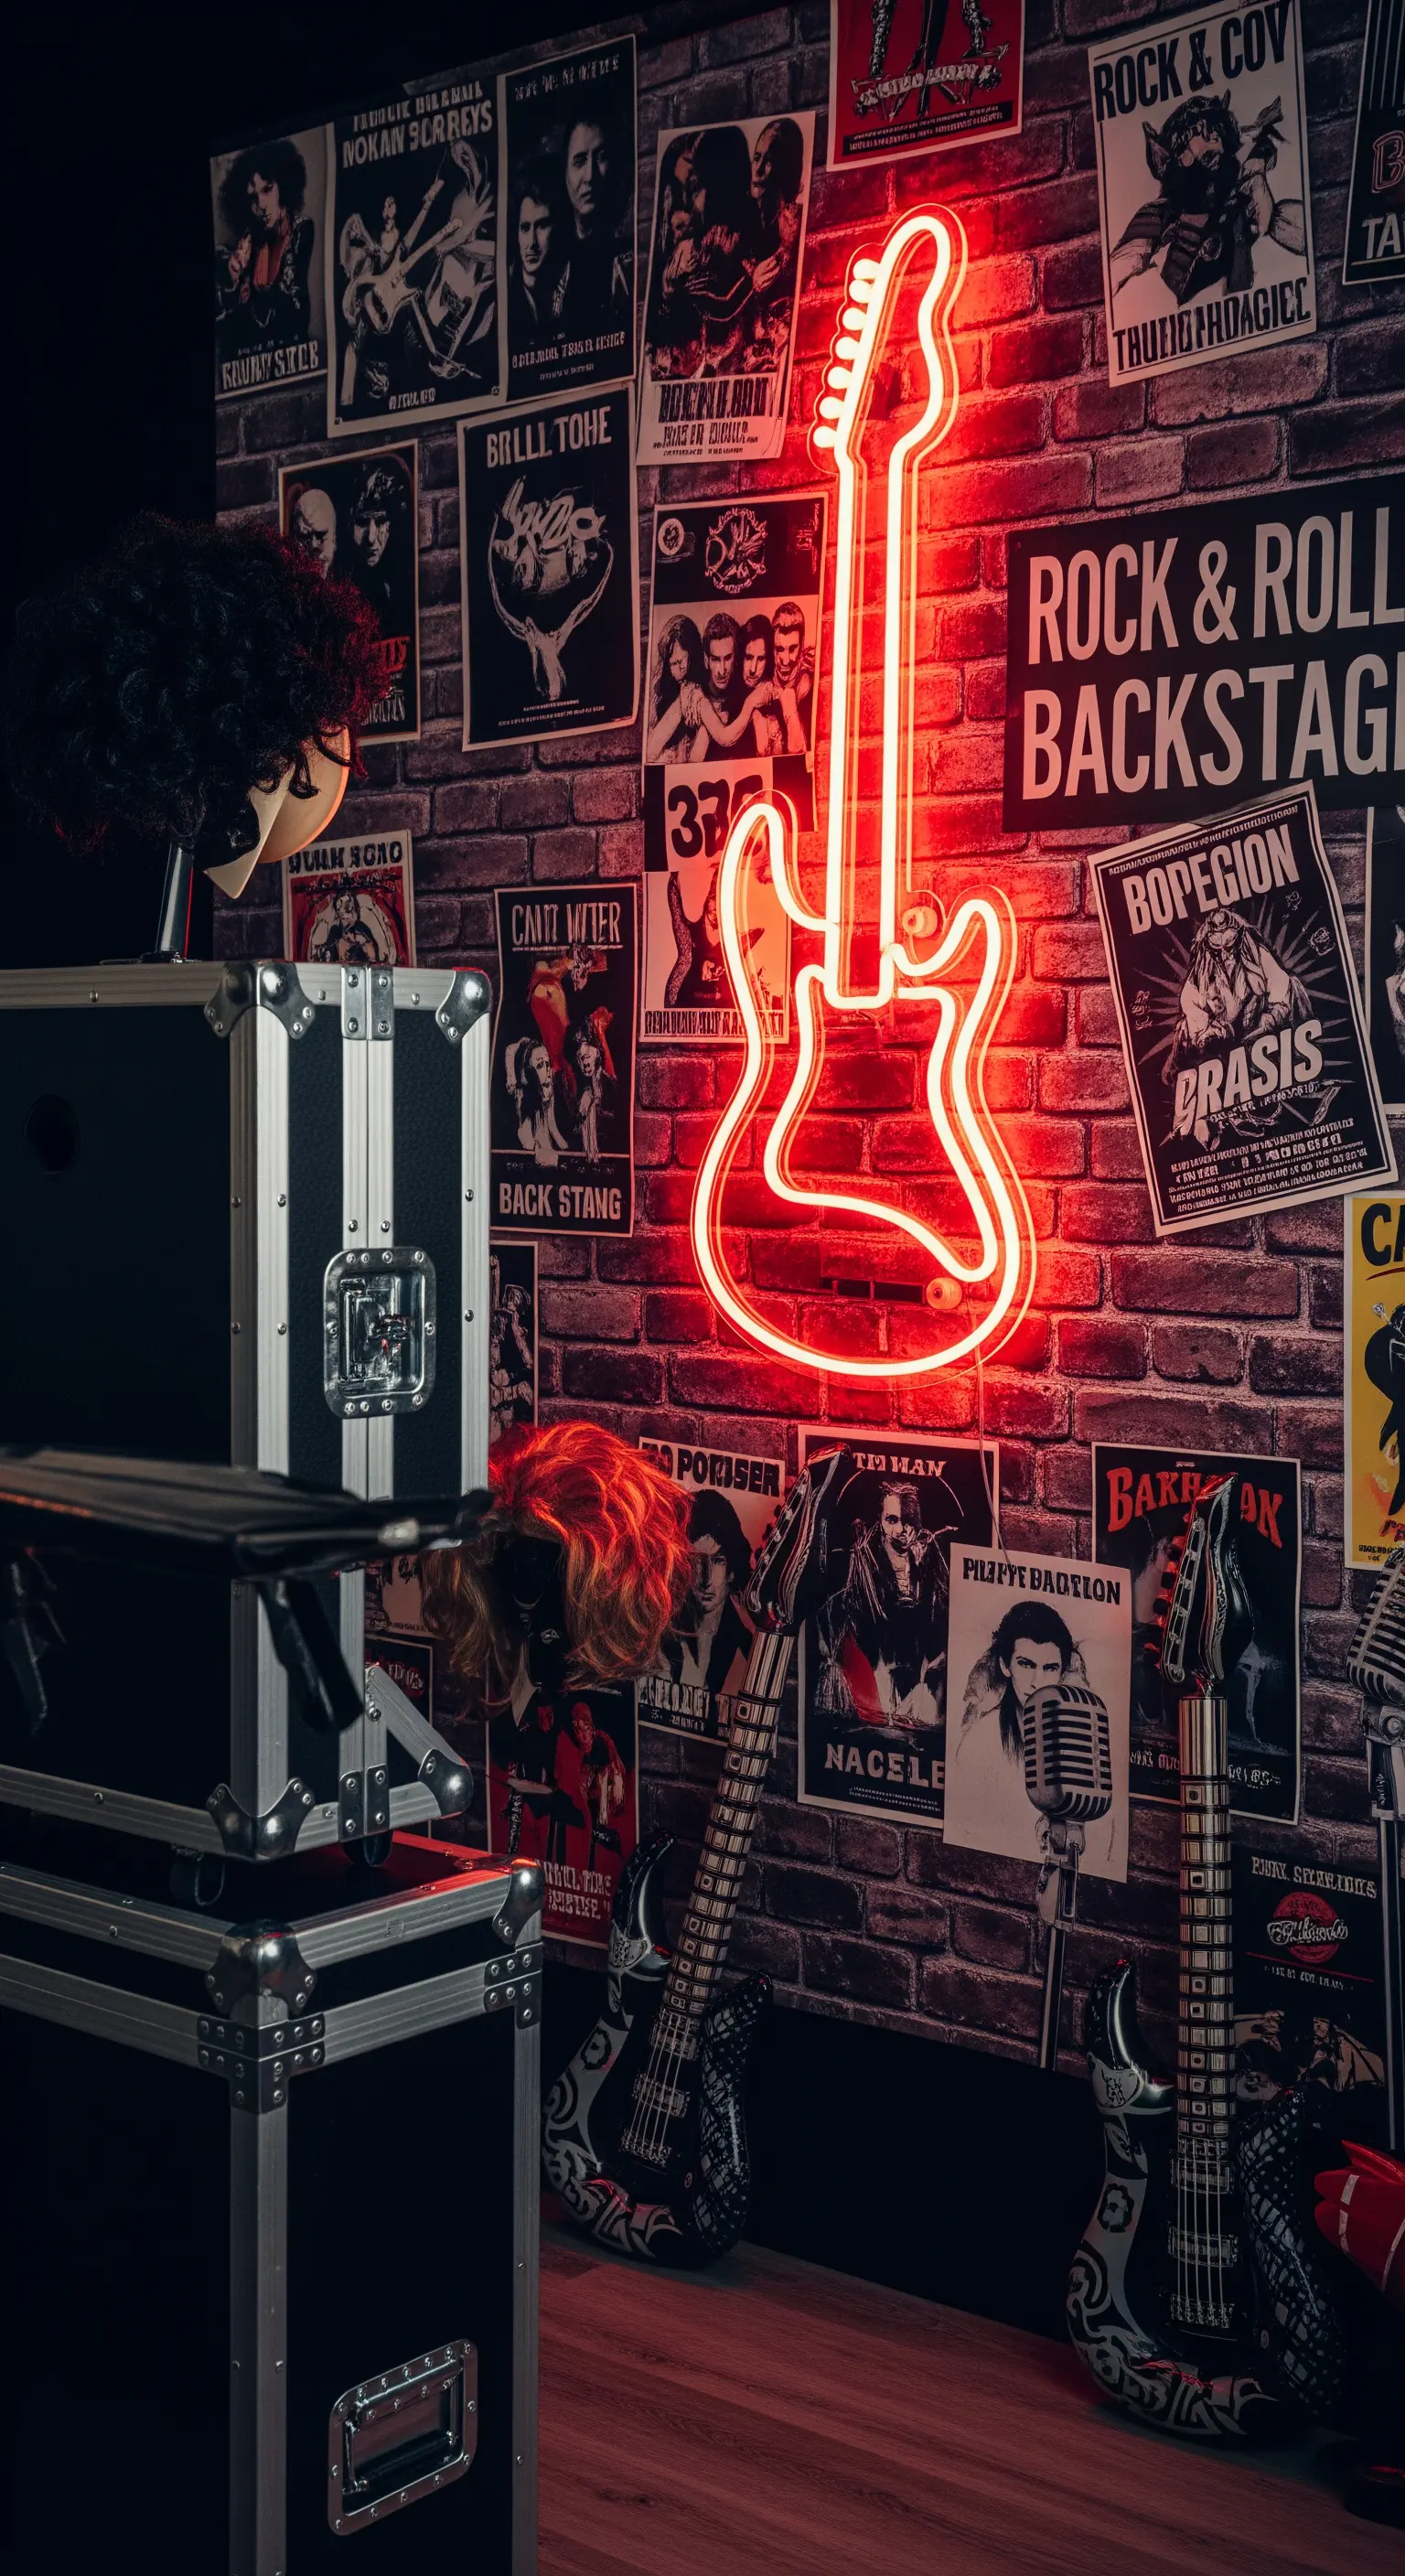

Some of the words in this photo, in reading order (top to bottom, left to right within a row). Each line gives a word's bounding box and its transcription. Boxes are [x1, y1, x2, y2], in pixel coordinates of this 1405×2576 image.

[1094, 38, 1183, 123] ROCK
[1028, 537, 1179, 665] ROCK
[1193, 540, 1239, 645] &
[1253, 507, 1405, 638] ROLL
[499, 1183, 552, 1217] BACK
[559, 1185, 622, 1220] STANG
